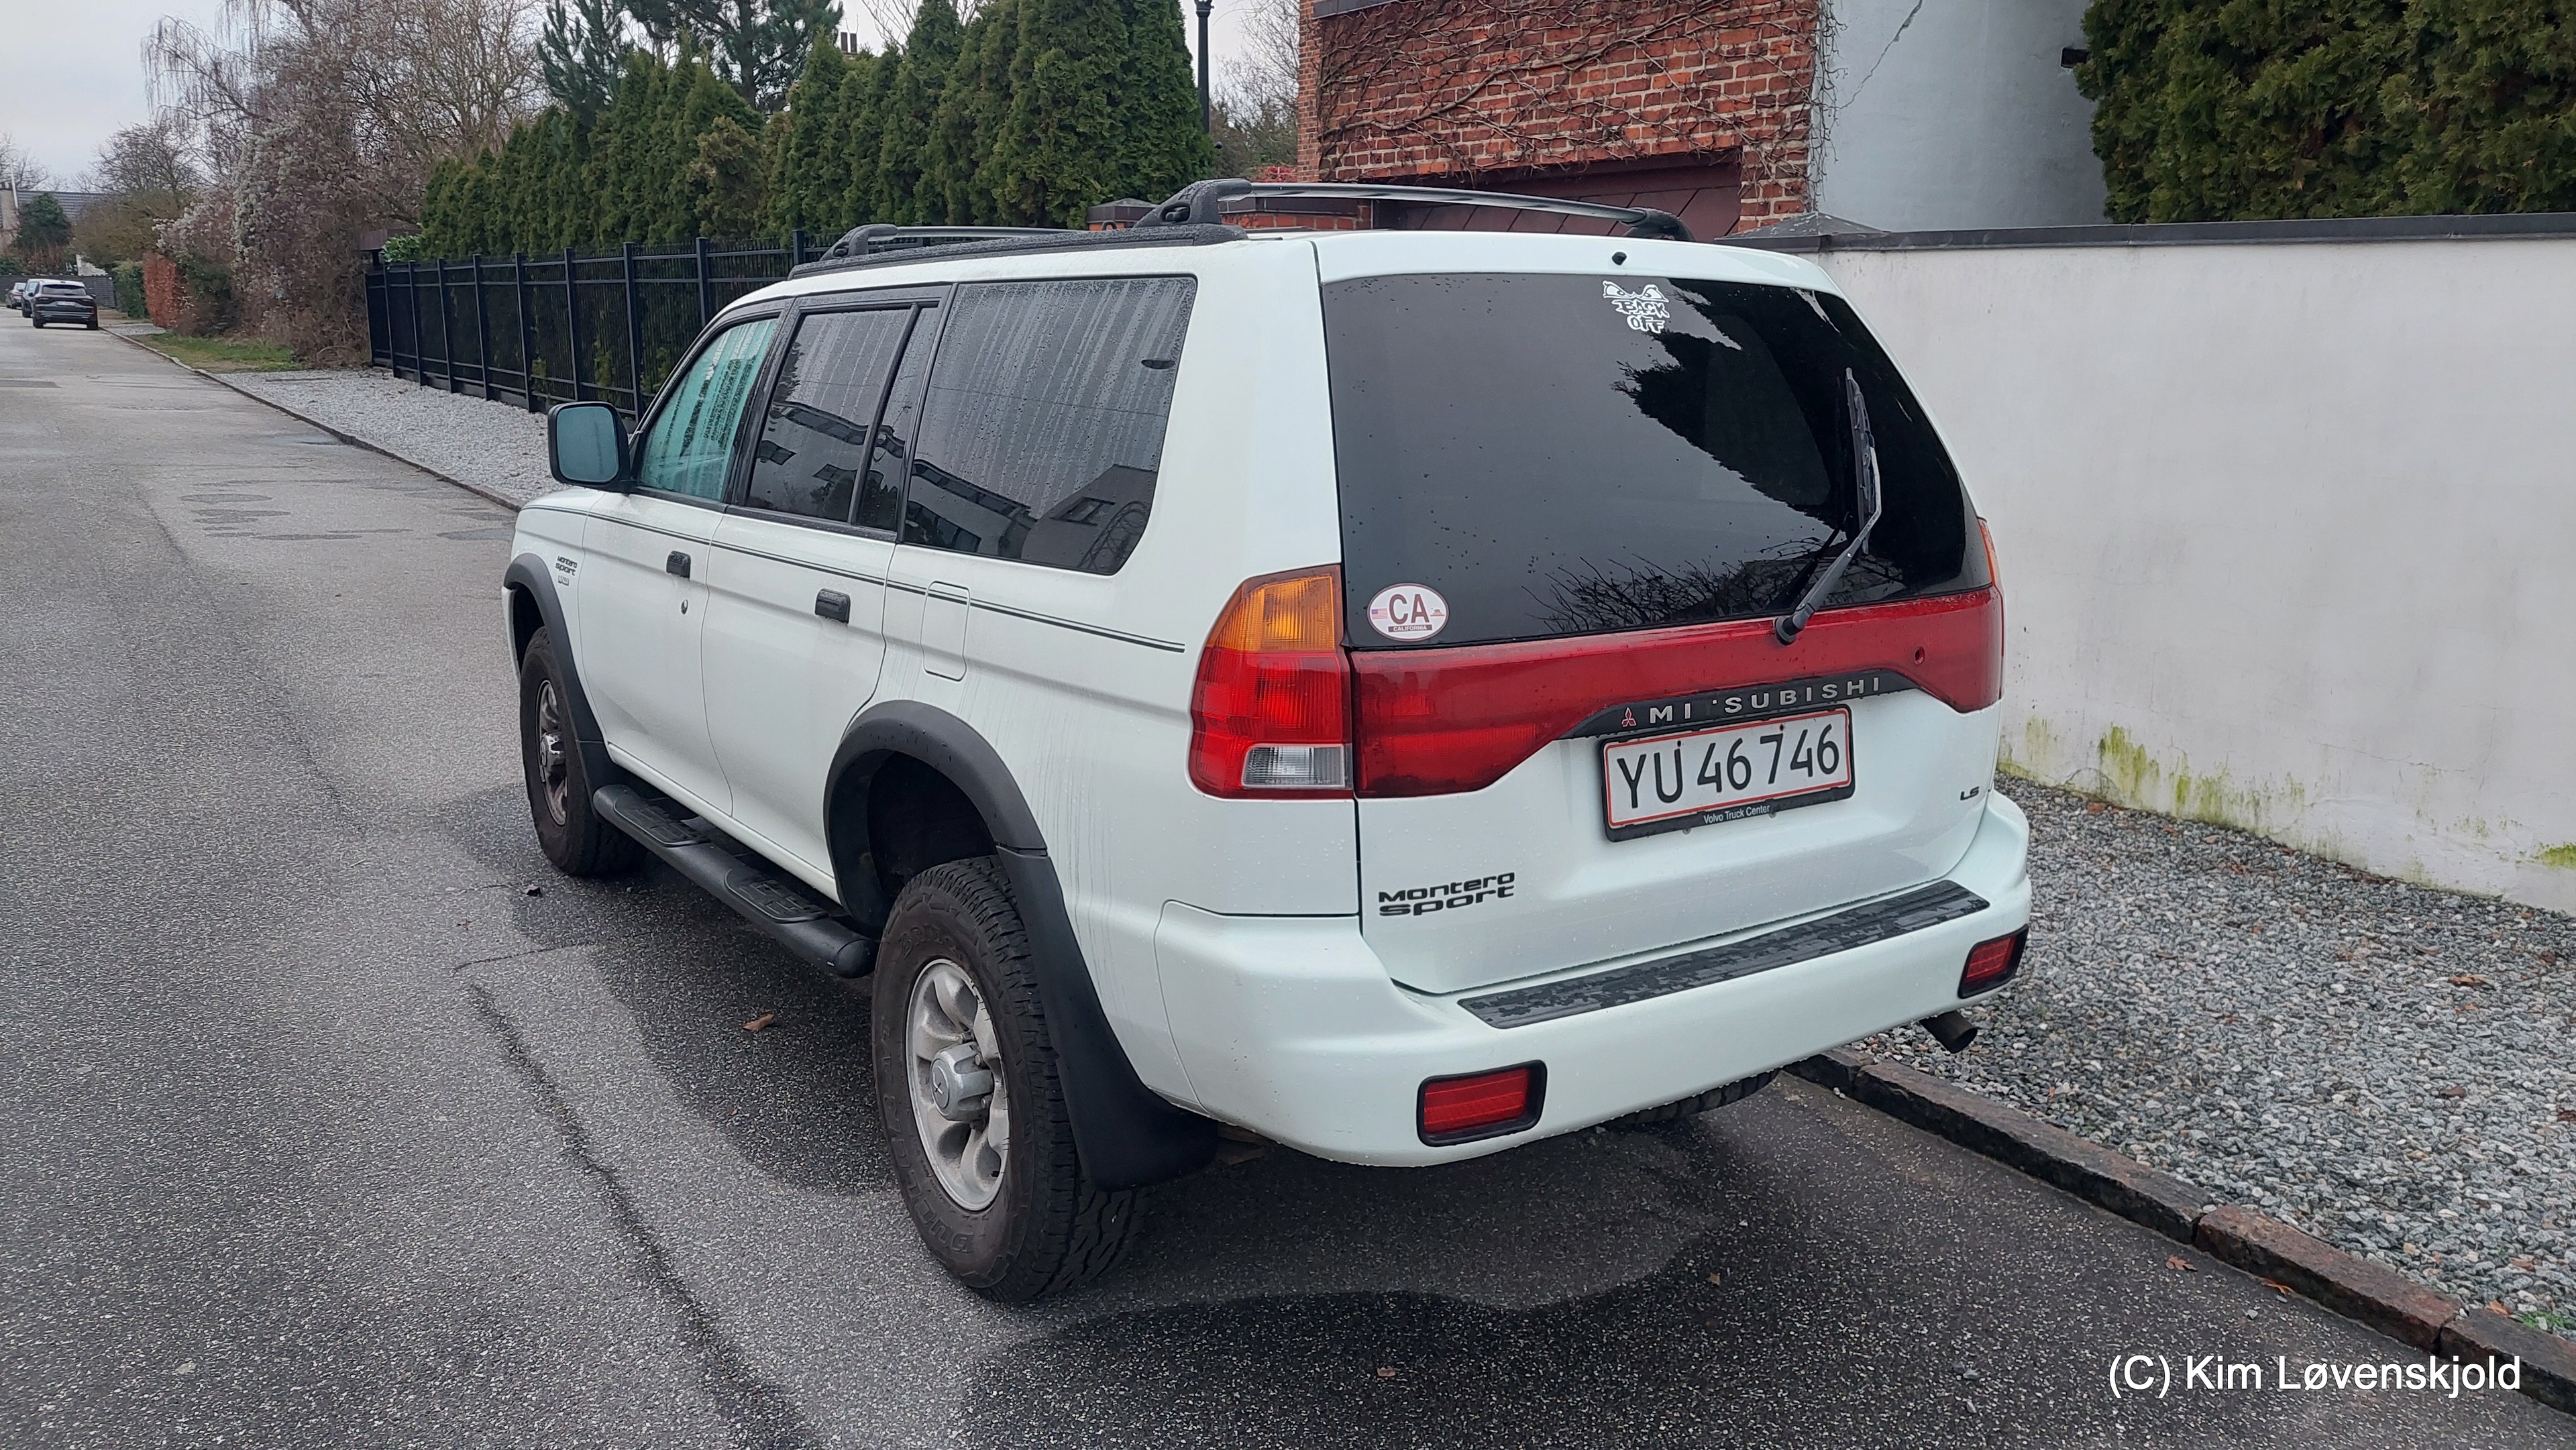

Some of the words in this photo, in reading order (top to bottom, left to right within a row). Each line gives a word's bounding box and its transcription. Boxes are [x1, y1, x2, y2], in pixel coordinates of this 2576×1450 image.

[1611, 298, 1670, 319] BACK
[1627, 315, 1665, 334] OFF
[1389, 594, 1430, 624] CA
[1650, 677, 1879, 724] MISUBISHI
[1617, 747, 1683, 809] YU
[1960, 786, 1980, 801] LS
[1703, 814, 1723, 824] Volvo
[1725, 808, 1744, 820] Truck
[1746, 805, 1770, 816] Center
[1379, 872, 1515, 903] Montero
